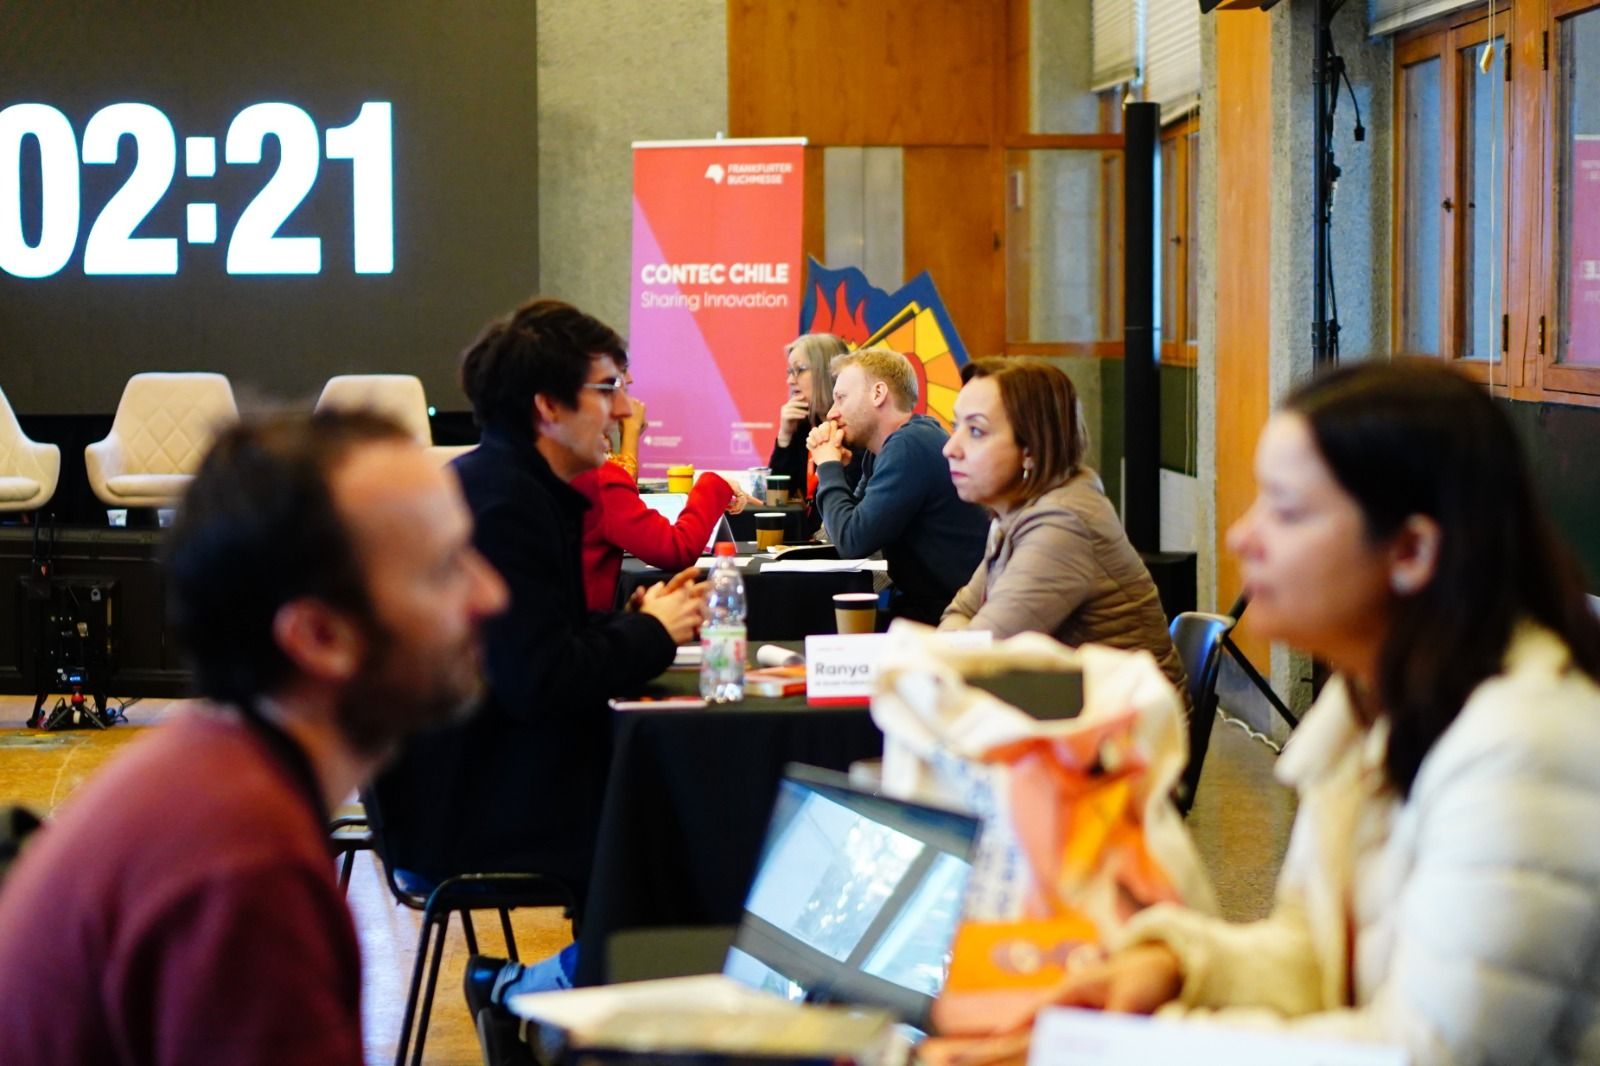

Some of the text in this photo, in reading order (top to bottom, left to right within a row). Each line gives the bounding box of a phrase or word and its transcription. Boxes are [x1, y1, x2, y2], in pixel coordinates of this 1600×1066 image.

[727, 162, 793, 174] FRANKFURTER
[727, 174, 783, 185] BUCHMESSE
[0, 102, 394, 278] 02:21
[641, 263, 789, 284] CONTEC CHILE
[641, 290, 788, 312] Sharing Innovation
[815, 662, 870, 677] Ranya
